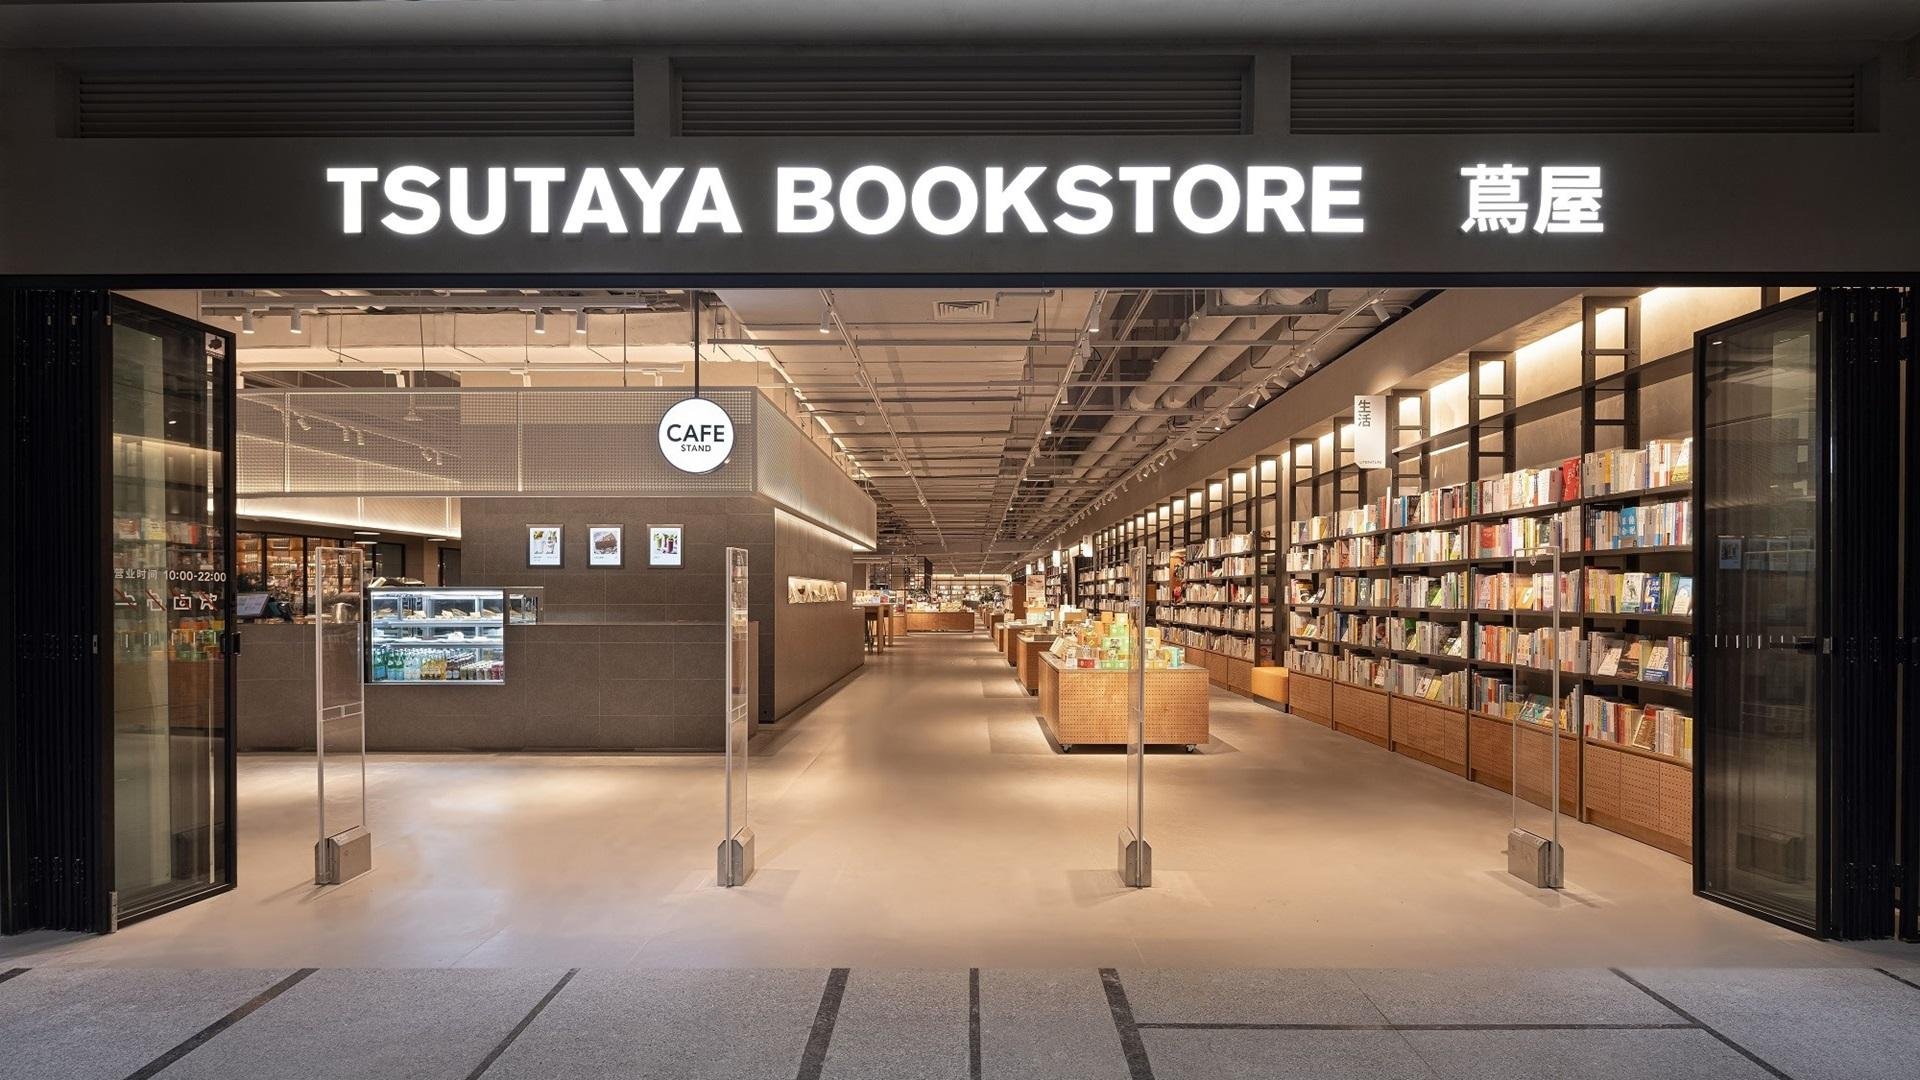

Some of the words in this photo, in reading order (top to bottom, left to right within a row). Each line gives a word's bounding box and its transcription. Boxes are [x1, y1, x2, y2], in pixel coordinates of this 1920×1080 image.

[325, 166, 743, 234] TSUTAYA
[776, 165, 1364, 235] BOOKSTORE
[1460, 163, 1604, 234] 蔦屋
[1358, 399, 1371, 427] 生活
[666, 423, 725, 443] CAFE
[680, 443, 712, 452] STAND
[113, 568, 158, 580] 营业时间
[163, 569, 227, 583] 10:00-22:00
